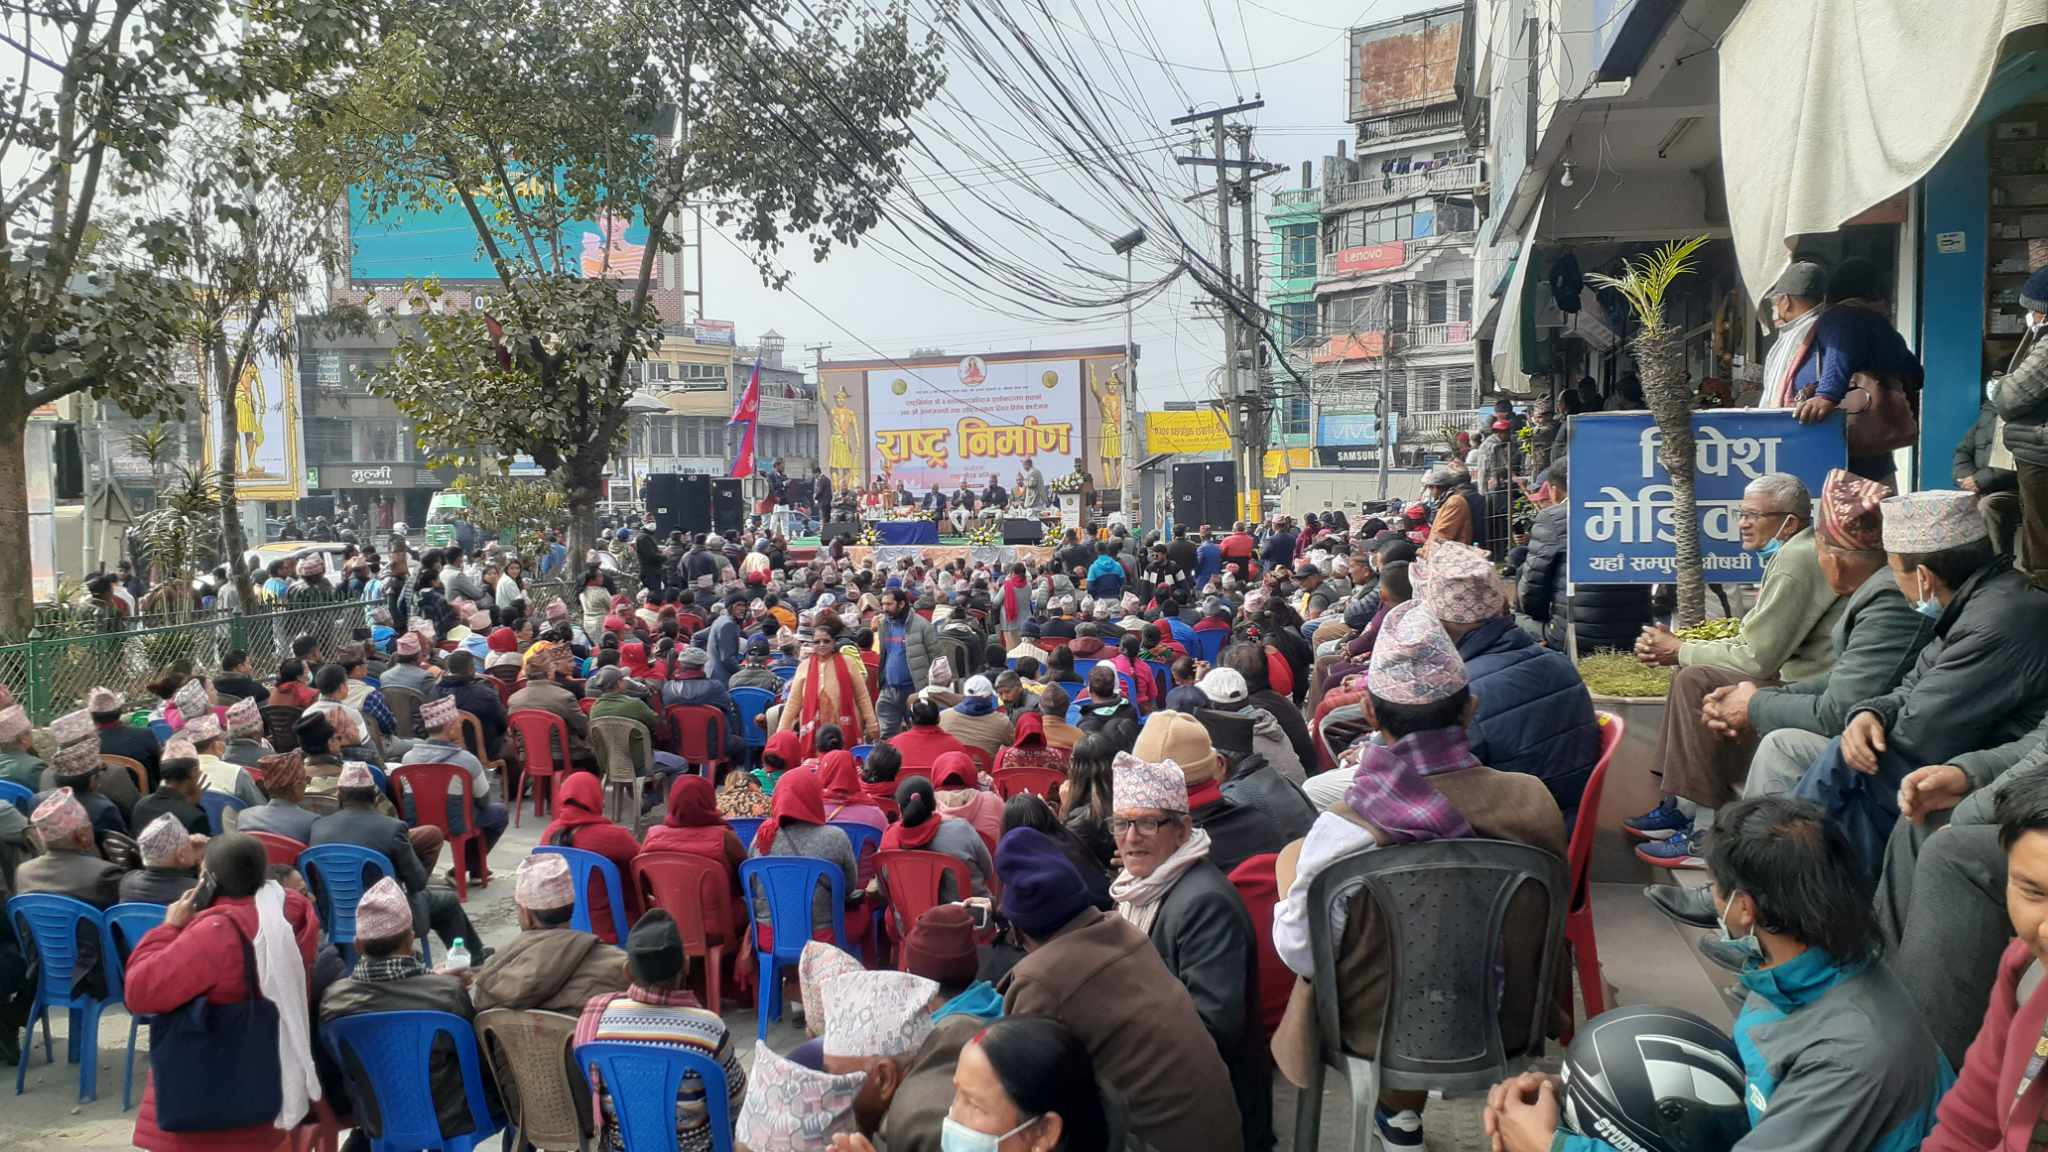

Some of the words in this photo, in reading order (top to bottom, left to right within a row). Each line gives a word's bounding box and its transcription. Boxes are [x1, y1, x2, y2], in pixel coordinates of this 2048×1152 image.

[1343, 248, 1383, 263] Lenovo
[876, 427, 949, 469] राष्ट्र
[957, 416, 1073, 457] निर्माण
[1337, 450, 1380, 462] SAMSUNG
[1589, 553, 1625, 571] यहाँ
